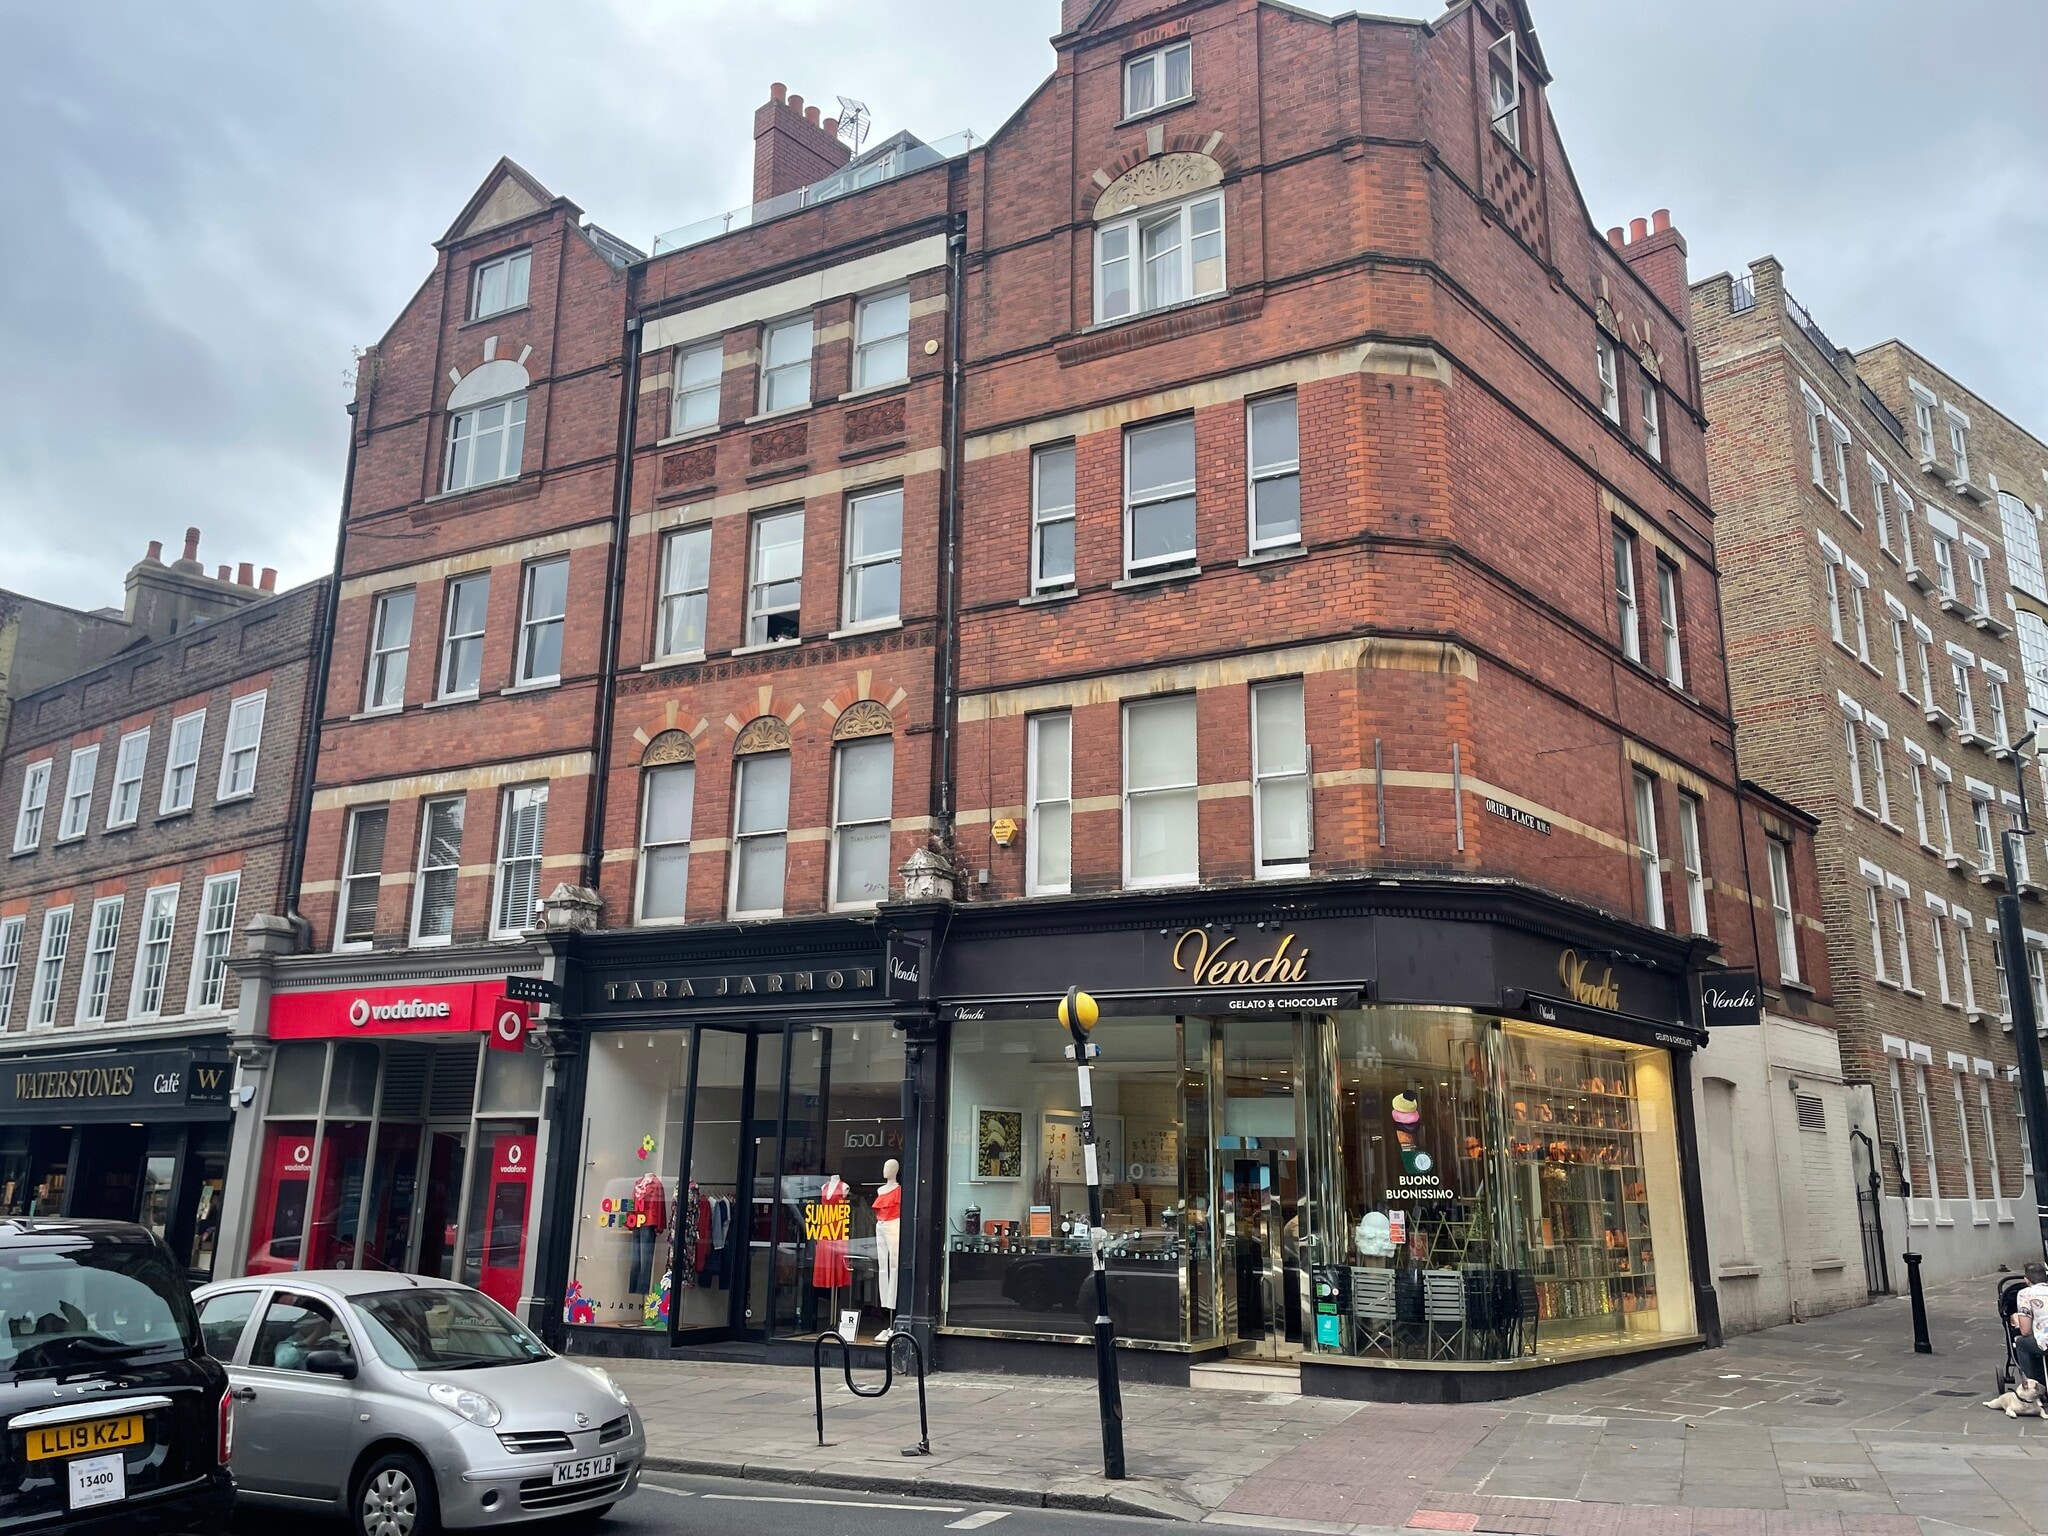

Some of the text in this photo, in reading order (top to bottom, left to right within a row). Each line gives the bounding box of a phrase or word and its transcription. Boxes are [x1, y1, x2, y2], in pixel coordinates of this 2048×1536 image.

[1485, 799, 1509, 819] ORIEL
[1511, 808, 1535, 829] PLACE
[1172, 928, 1309, 985] Venchi
[890, 956, 919, 982] Venchi
[519, 982, 543, 990] TARA
[604, 968, 874, 1000] TARA JARMON
[1558, 949, 1620, 1011] Venchi
[511, 988, 550, 998] JARMON
[1704, 988, 1755, 1009] Venchi
[372, 1000, 450, 1020] vodafone
[954, 1006, 986, 1020] Venchi
[1229, 998, 1338, 1009] GELATO & CHOCOLATE
[1538, 1003, 1556, 1021] Venchi
[15, 1066, 135, 1099] WATERSTONES
[153, 1072, 180, 1094] Café
[196, 1068, 224, 1089] W
[500, 1165, 527, 1174] vodafone
[1399, 1175, 1440, 1186] BUONO
[1386, 1189, 1454, 1199] BUONISSIMO
[601, 1198, 645, 1213] QUEEN
[805, 1204, 851, 1225] SUMMER
[599, 1214, 647, 1228] OF POP
[805, 1218, 850, 1241] WAVE
[609, 1301, 644, 1310] JARM
[53, 1382, 128, 1397] LEVC
[42, 1420, 131, 1453] LL19 KZJ
[558, 1457, 612, 1481] KL55 YLB
[80, 1473, 113, 1488] 13400
